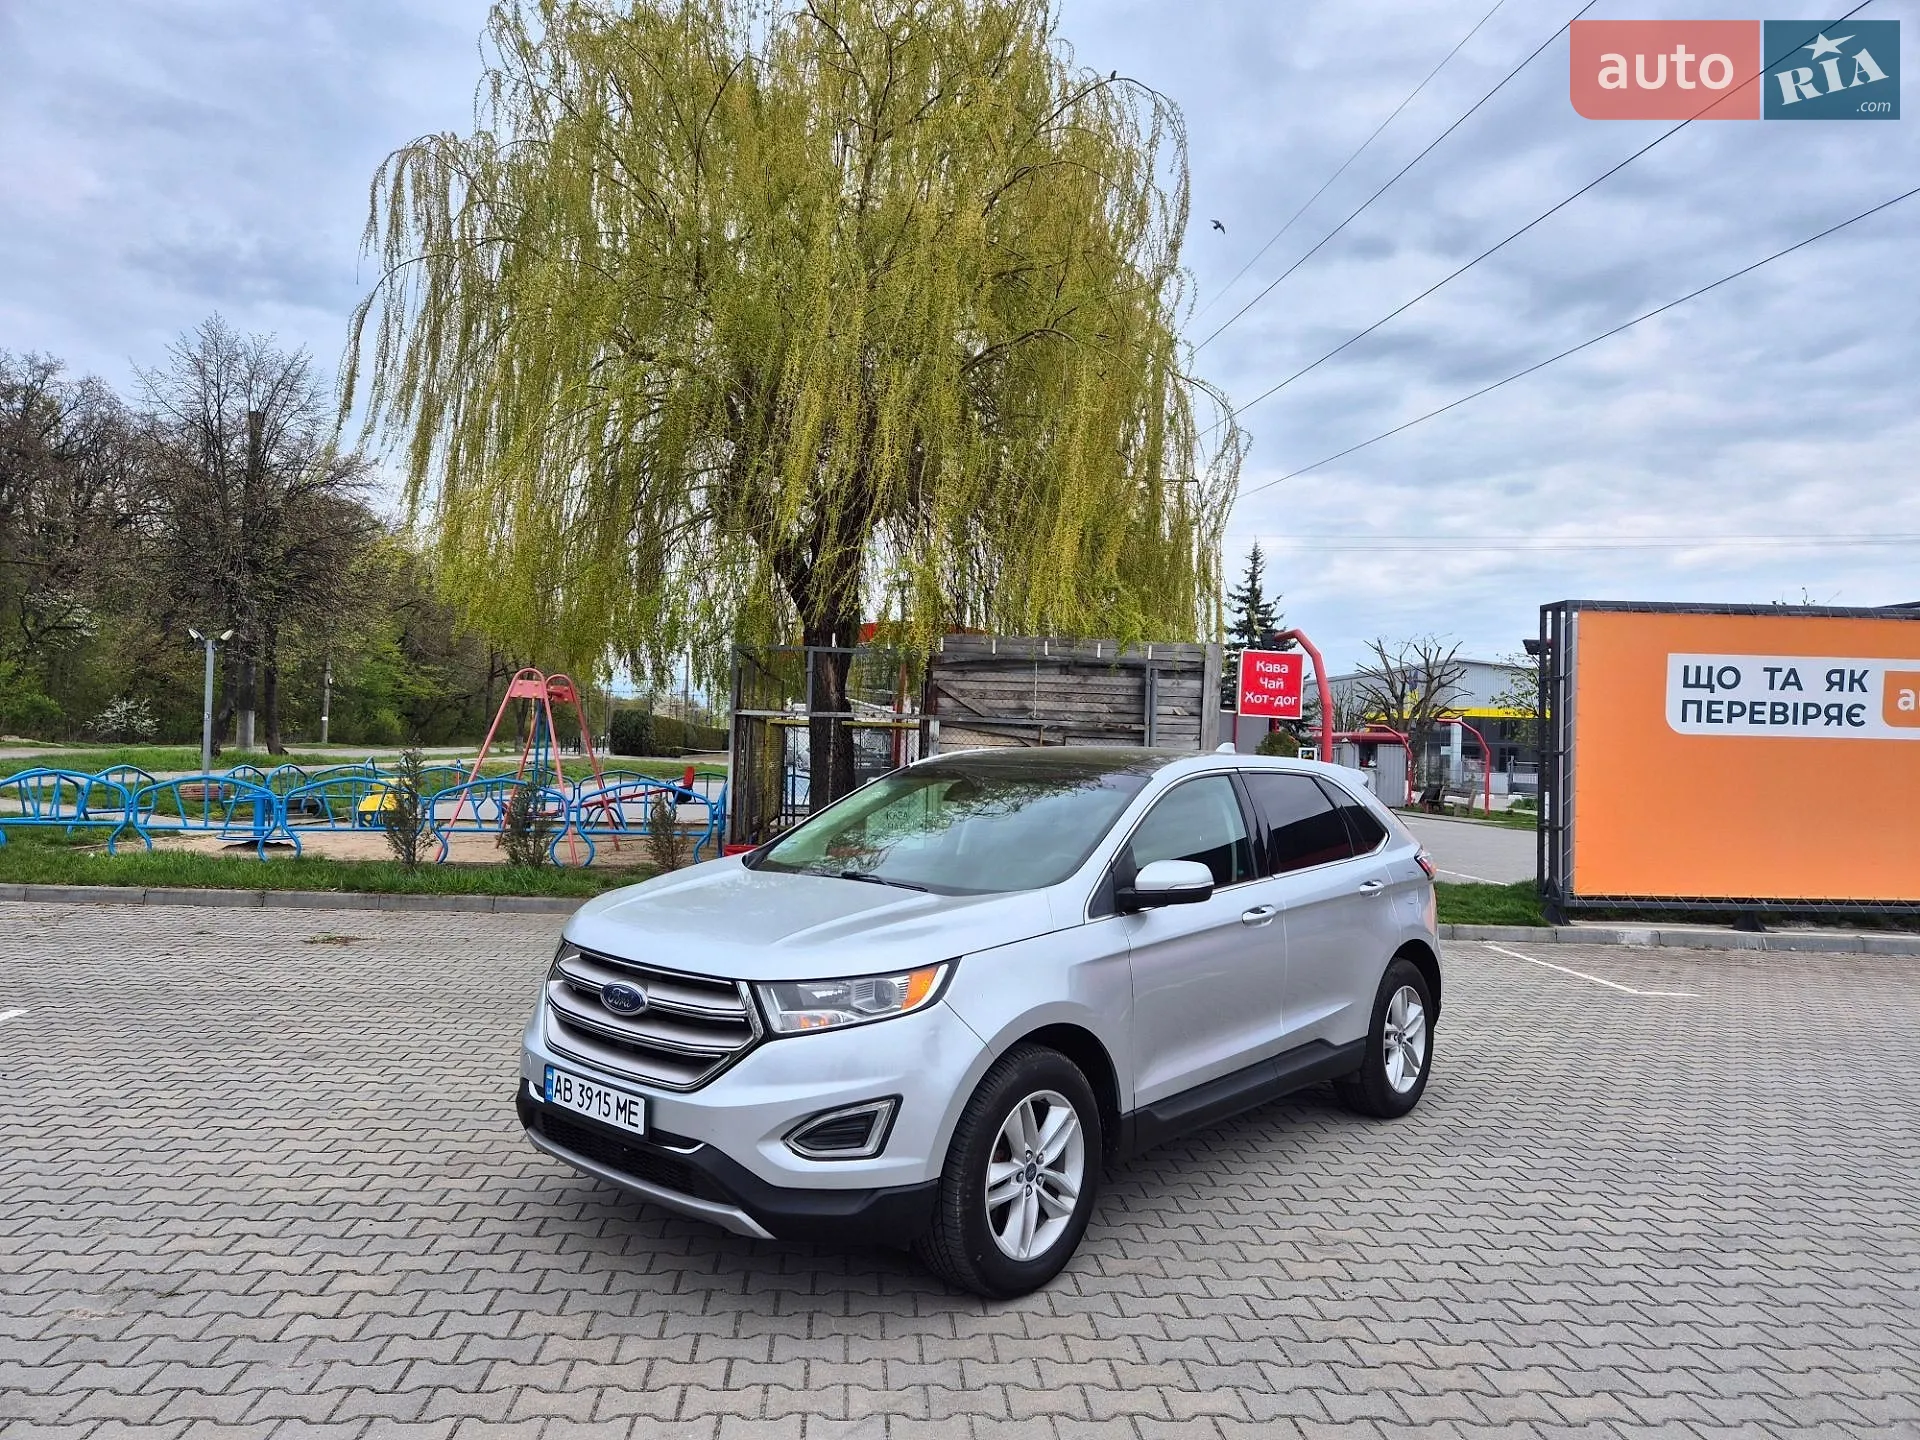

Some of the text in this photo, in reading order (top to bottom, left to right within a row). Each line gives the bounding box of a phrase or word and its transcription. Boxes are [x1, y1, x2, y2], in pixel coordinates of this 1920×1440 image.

[1256, 661, 1289, 674] Кава
[1682, 665, 1869, 693] ЩО ТА ЯК
[1260, 677, 1284, 690] Чай
[1245, 691, 1298, 707] Хот-дог
[1897, 688, 1920, 711] a
[1681, 700, 1866, 727] ПЕРЕВІРЯЄ
[553, 1075, 639, 1128] AB 3915 ME
